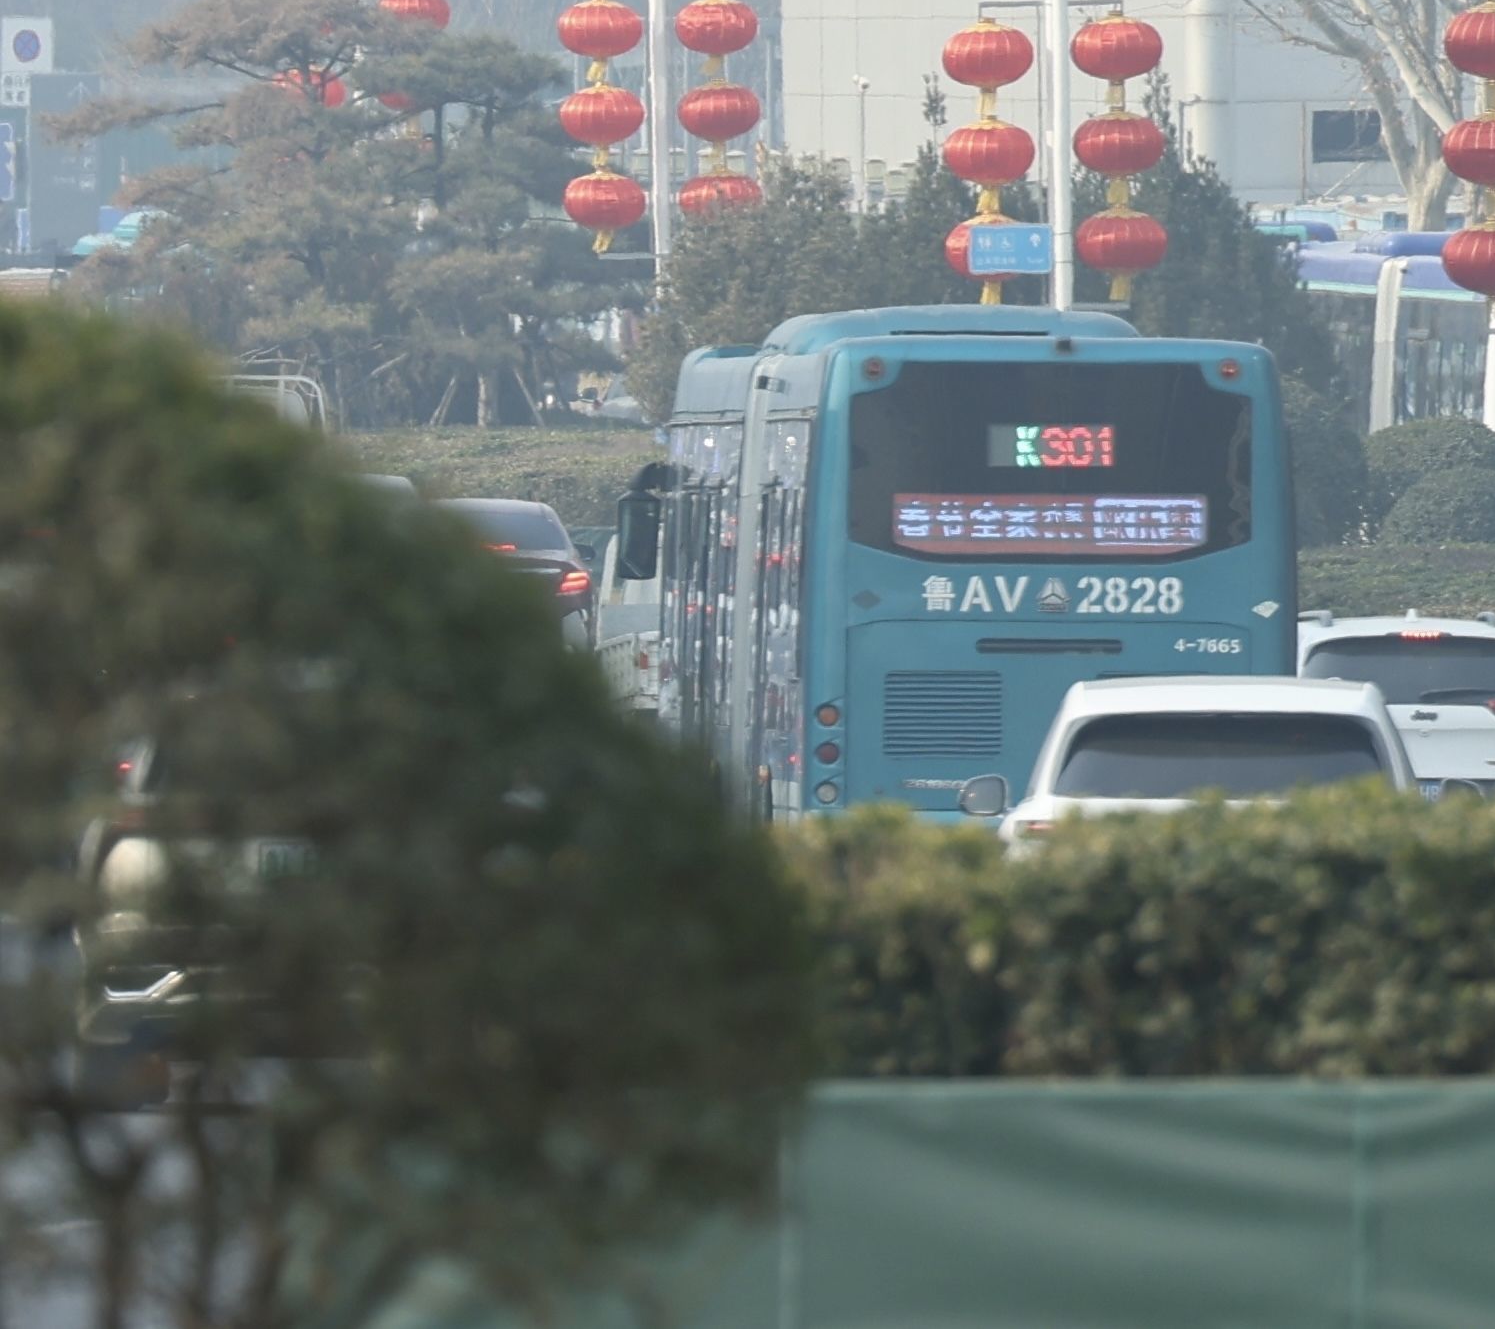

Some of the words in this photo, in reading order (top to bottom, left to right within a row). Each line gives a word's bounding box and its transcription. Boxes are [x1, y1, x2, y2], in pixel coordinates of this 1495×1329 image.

[1015, 425, 1114, 467] K301
[921, 574, 1029, 614] 鲁AV
[1076, 575, 1184, 615] 2828
[1173, 638, 1241, 654] 4-7665
